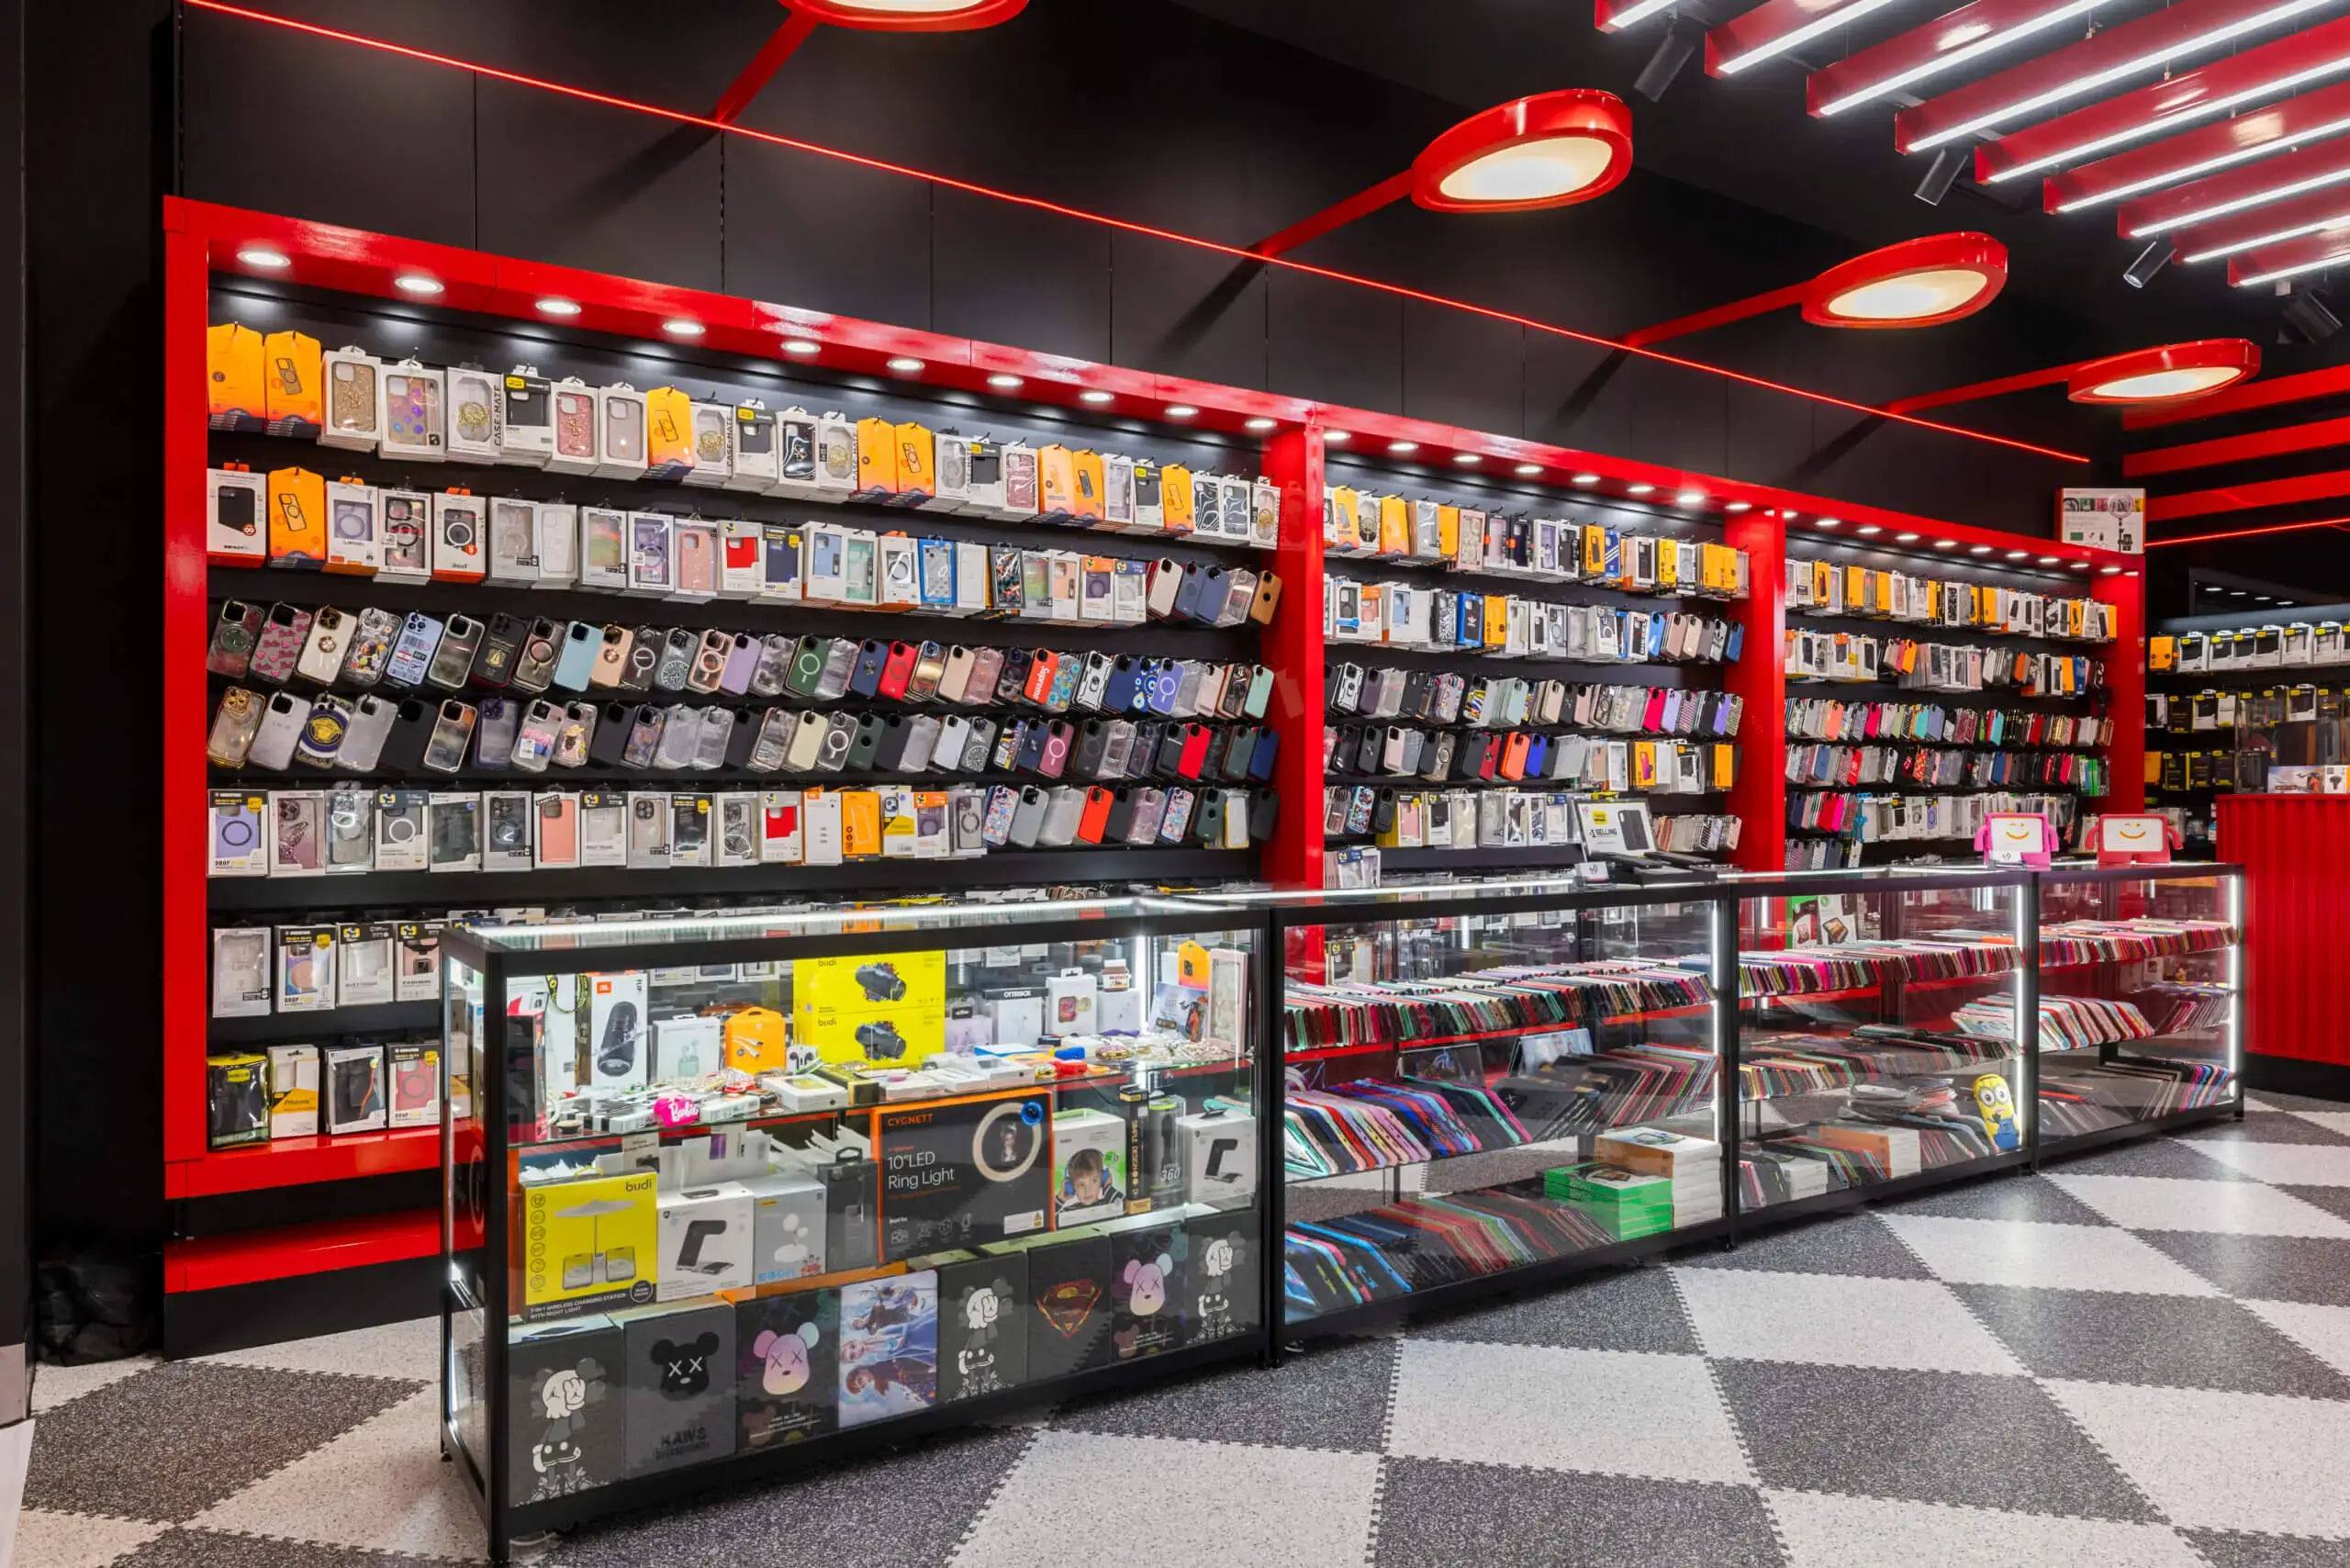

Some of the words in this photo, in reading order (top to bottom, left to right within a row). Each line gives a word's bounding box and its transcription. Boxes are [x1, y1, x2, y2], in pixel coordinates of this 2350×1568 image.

[1032, 666, 1050, 700] Supreme
[818, 1017, 837, 1026] budi
[888, 1113, 934, 1127] CYGNETT
[888, 1174, 919, 1190] Ring
[922, 1168, 955, 1186] Light
[1160, 1168, 1181, 1182] 360
[625, 1180, 653, 1193] budi
[660, 1426, 707, 1447] KAWS
